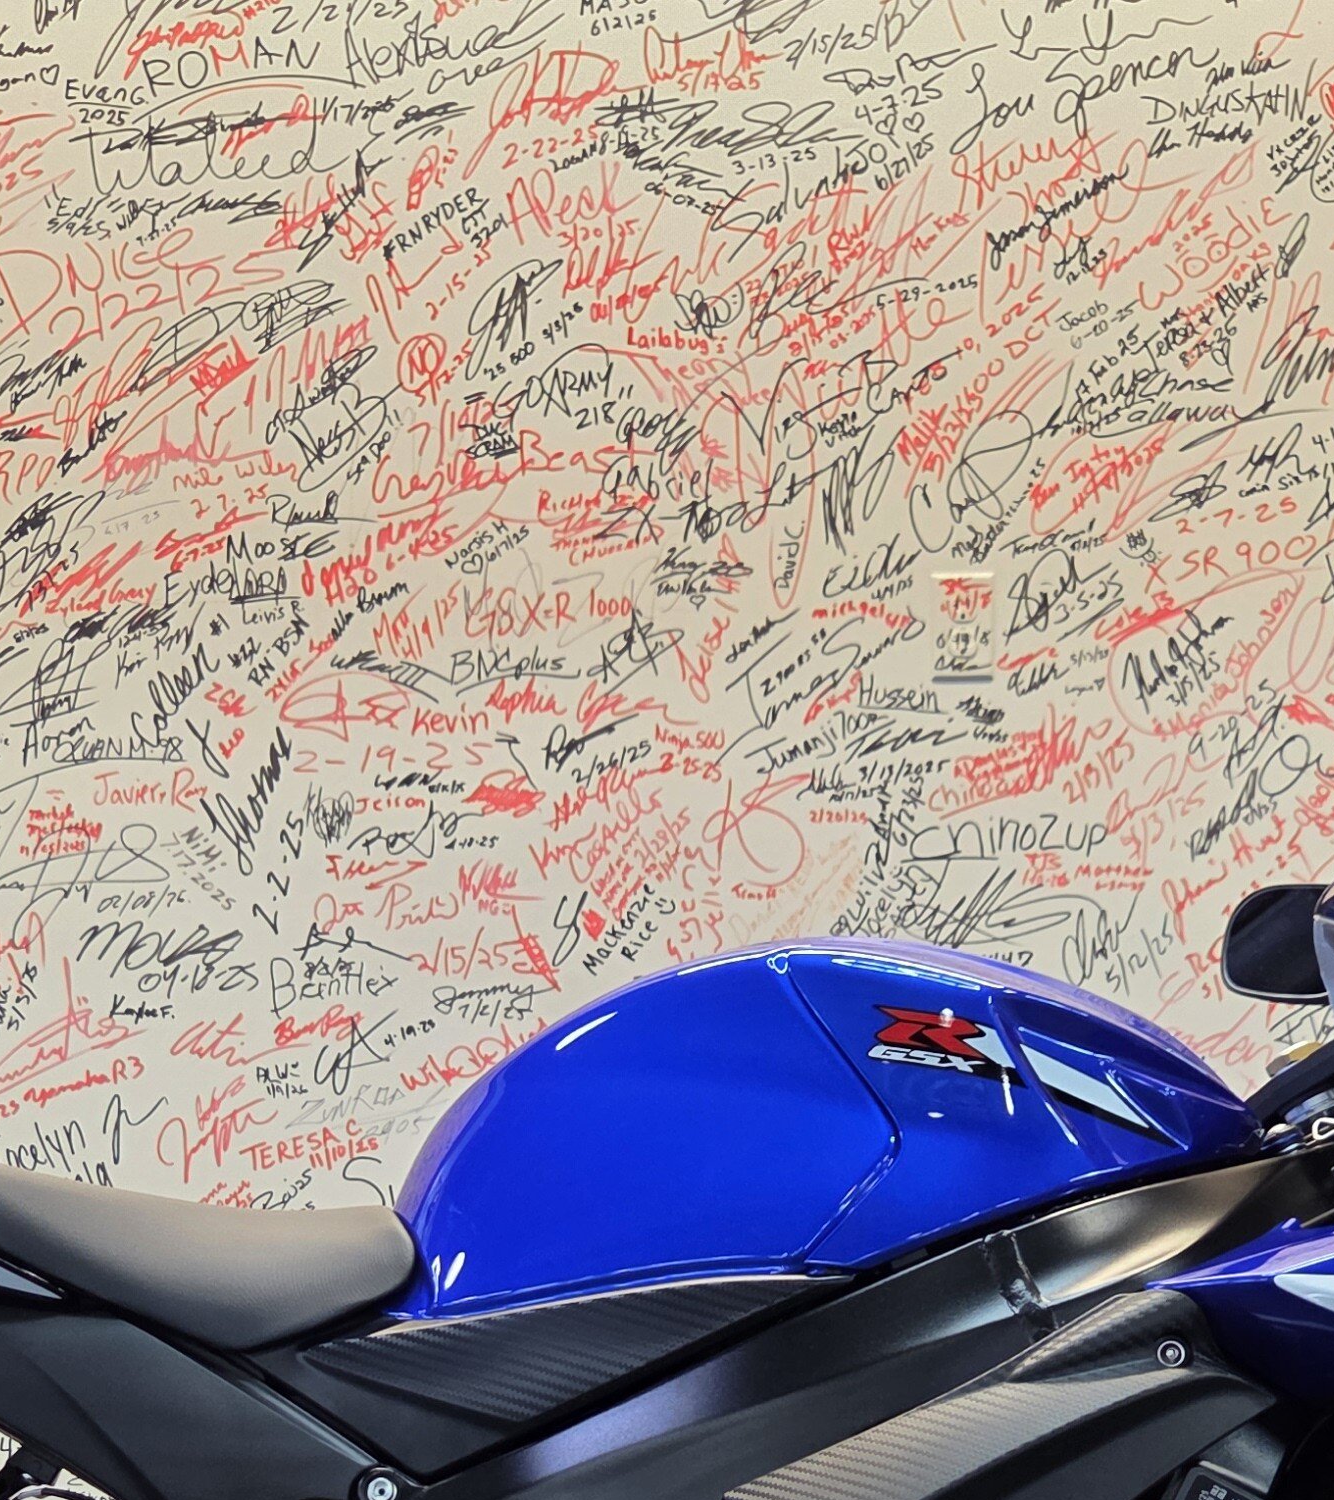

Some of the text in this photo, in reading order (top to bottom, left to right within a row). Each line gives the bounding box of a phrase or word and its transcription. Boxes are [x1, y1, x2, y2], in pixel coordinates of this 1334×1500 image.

[141, 37, 322, 98] ROMAN
[79, 107, 131, 127] 2025
[874, 274, 980, 311] 5-29-2025
[1053, 299, 1110, 335] Jacob
[773, 539, 802, 590] David
[857, 675, 949, 714] Hussein
[411, 705, 491, 738] Kevin
[582, 883, 656, 977] Mackenzie
[620, 920, 658, 962] Rice
[239, 1124, 340, 1171] TERESA
